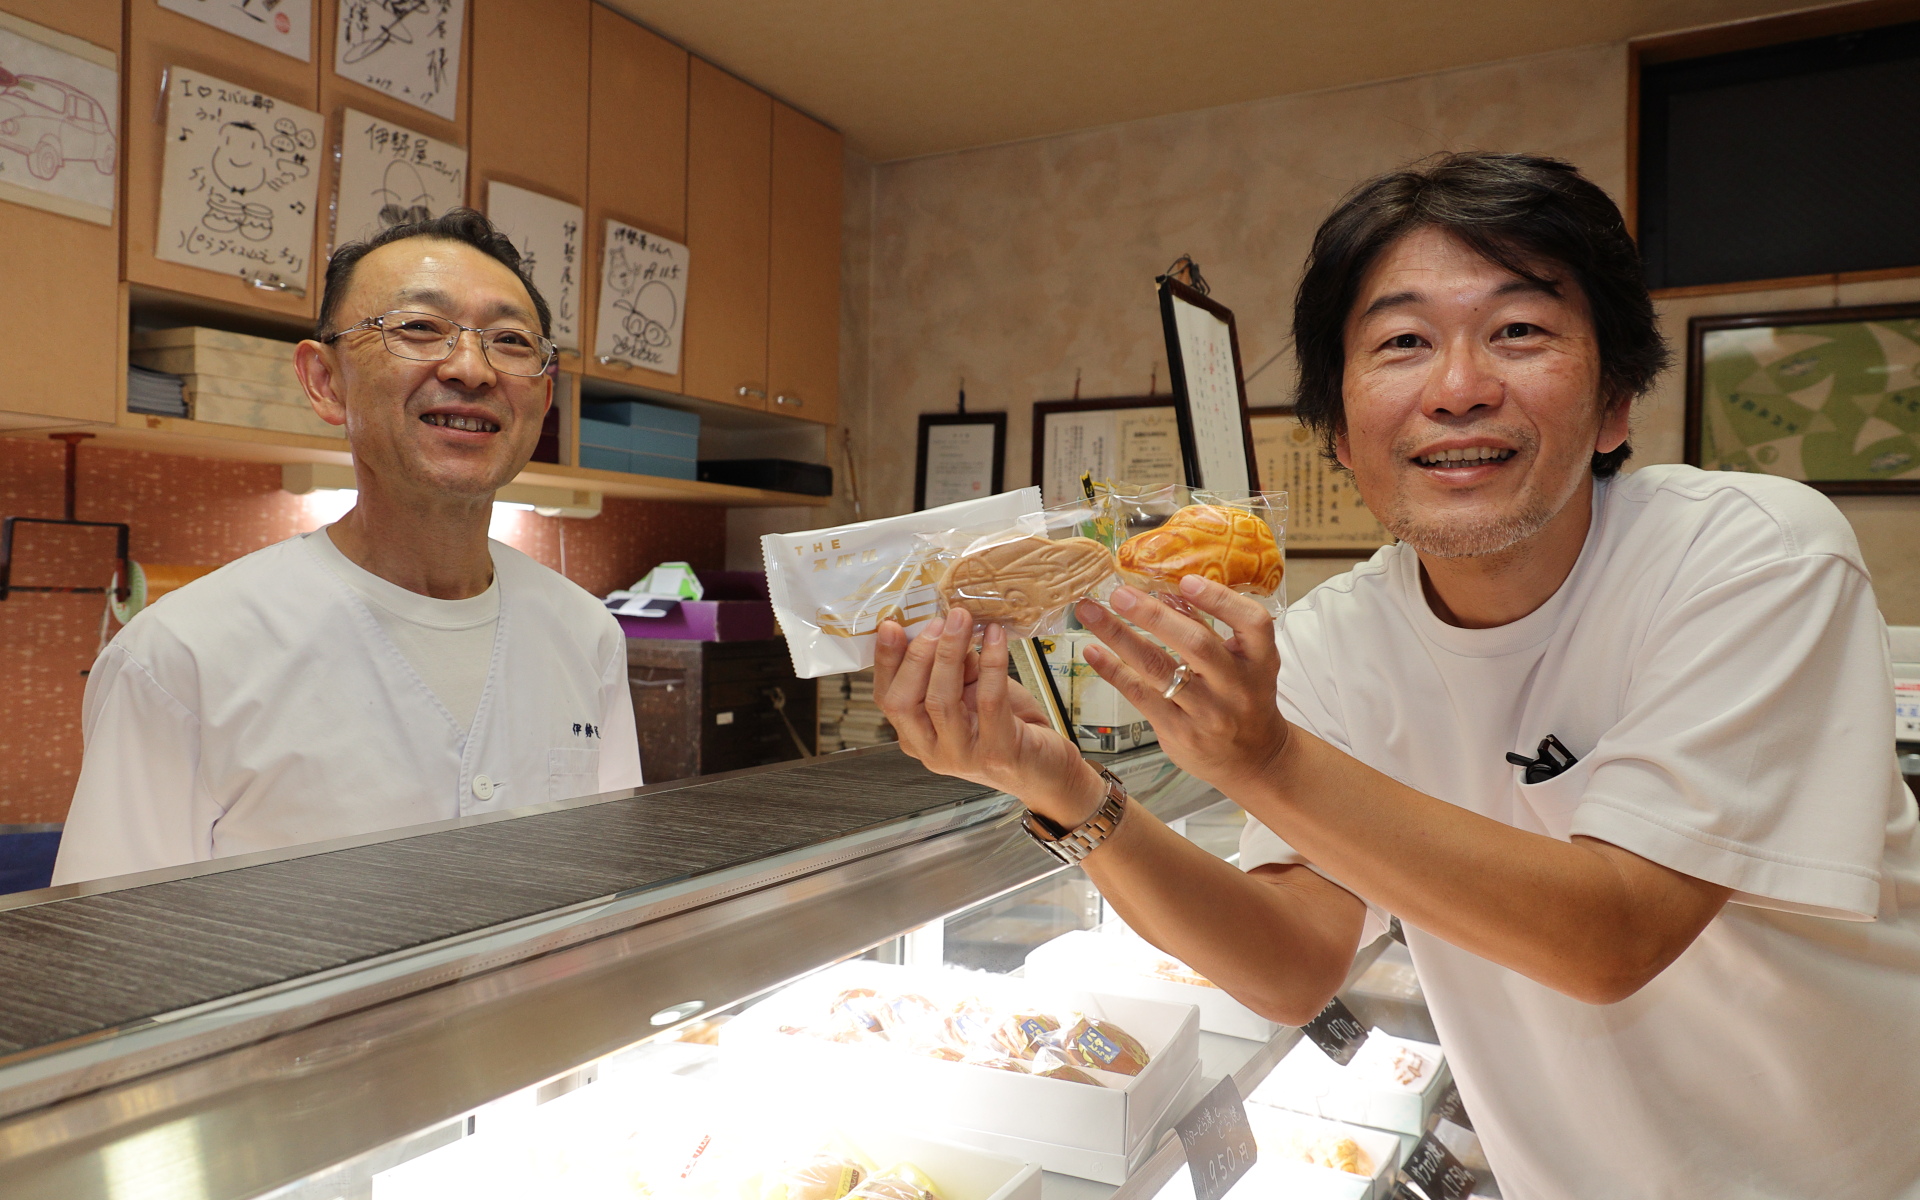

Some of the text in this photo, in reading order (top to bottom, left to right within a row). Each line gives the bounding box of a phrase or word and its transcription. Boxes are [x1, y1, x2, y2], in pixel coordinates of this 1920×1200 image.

[794, 539, 841, 557] THE
[812, 549, 878, 573] スバル
[1327, 1018, 1366, 1046] 970円
